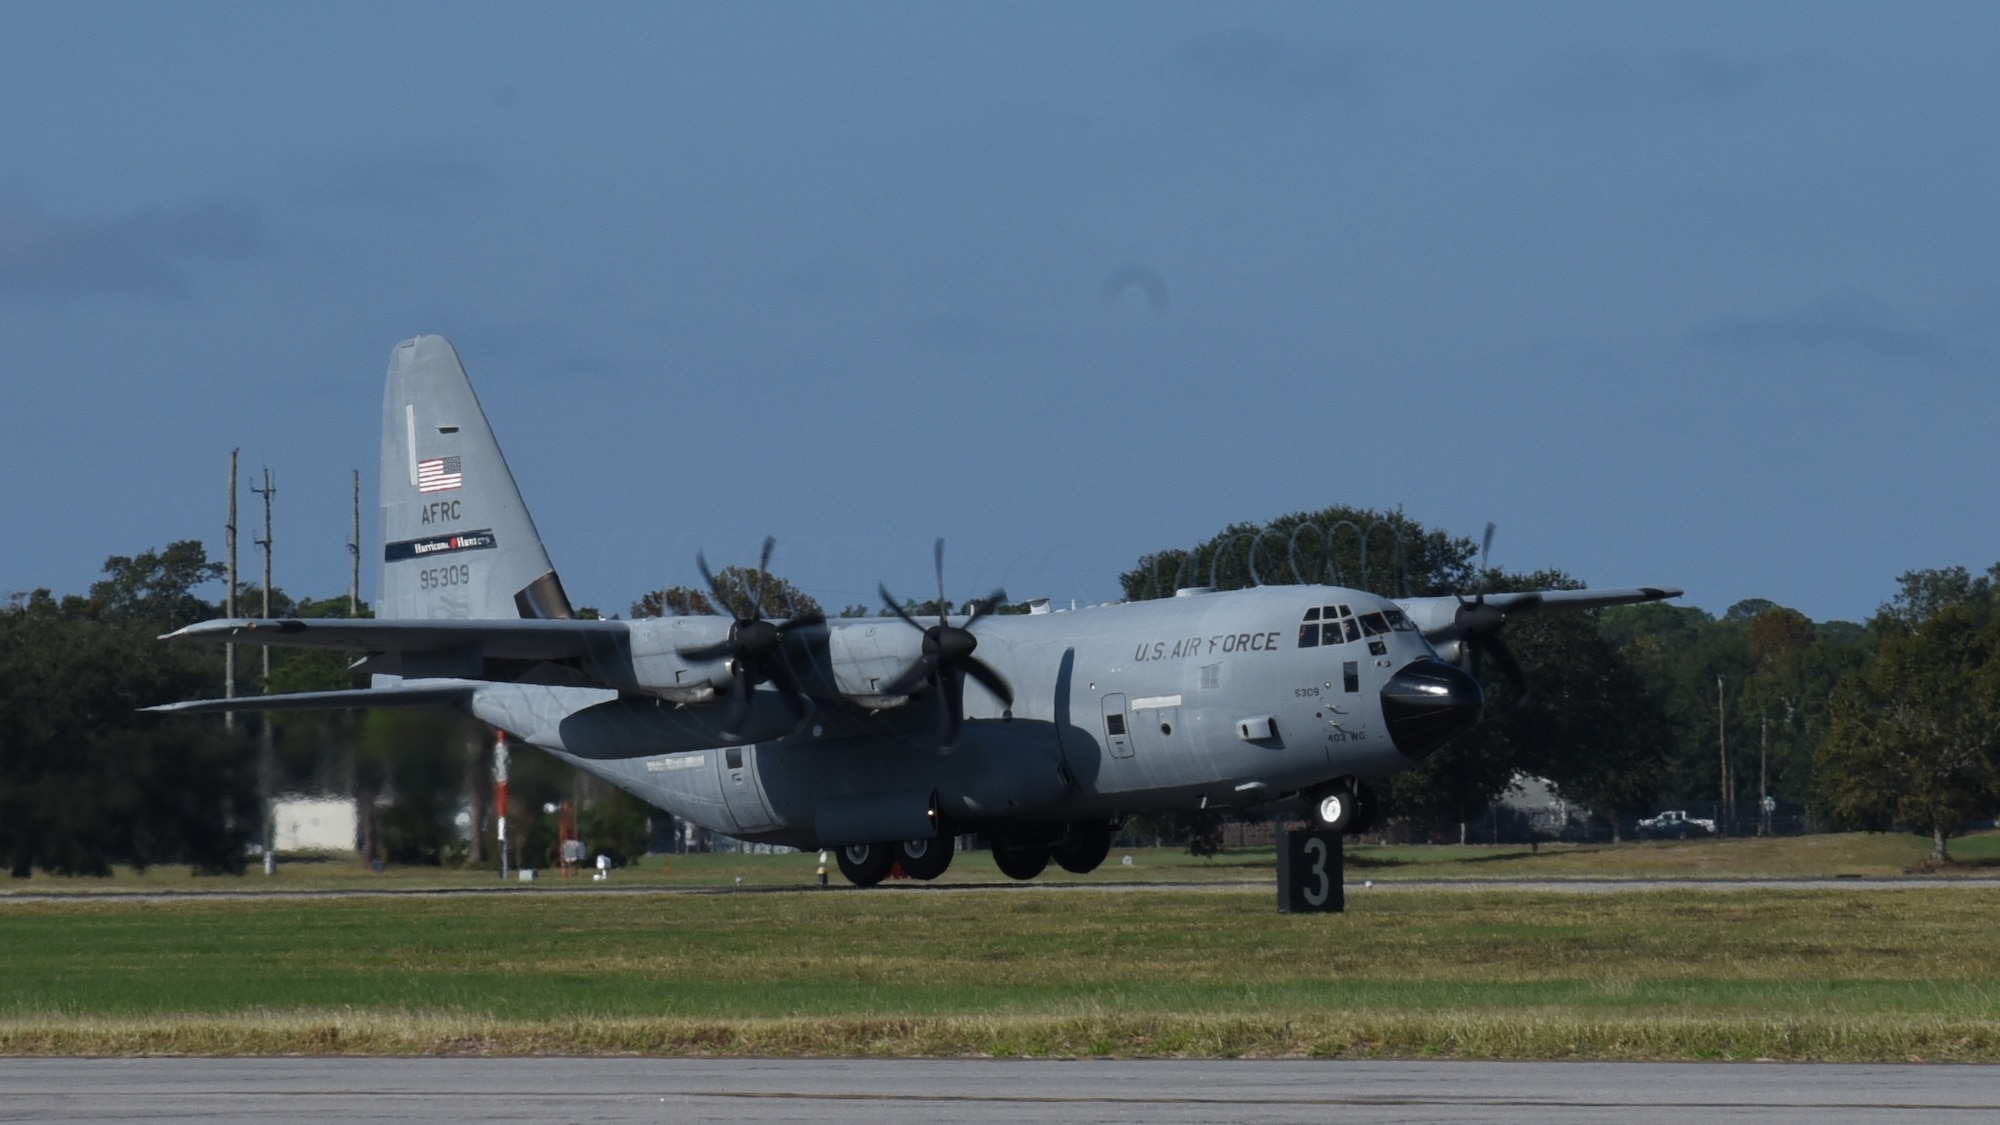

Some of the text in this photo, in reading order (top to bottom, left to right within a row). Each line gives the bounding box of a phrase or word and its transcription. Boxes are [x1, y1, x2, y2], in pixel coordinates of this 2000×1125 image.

[421, 500, 461, 526] AFRC
[420, 564, 470, 590] 95309
[1135, 632, 1281, 662] U.S. AIR FORCE
[1303, 837, 1329, 906] 3
